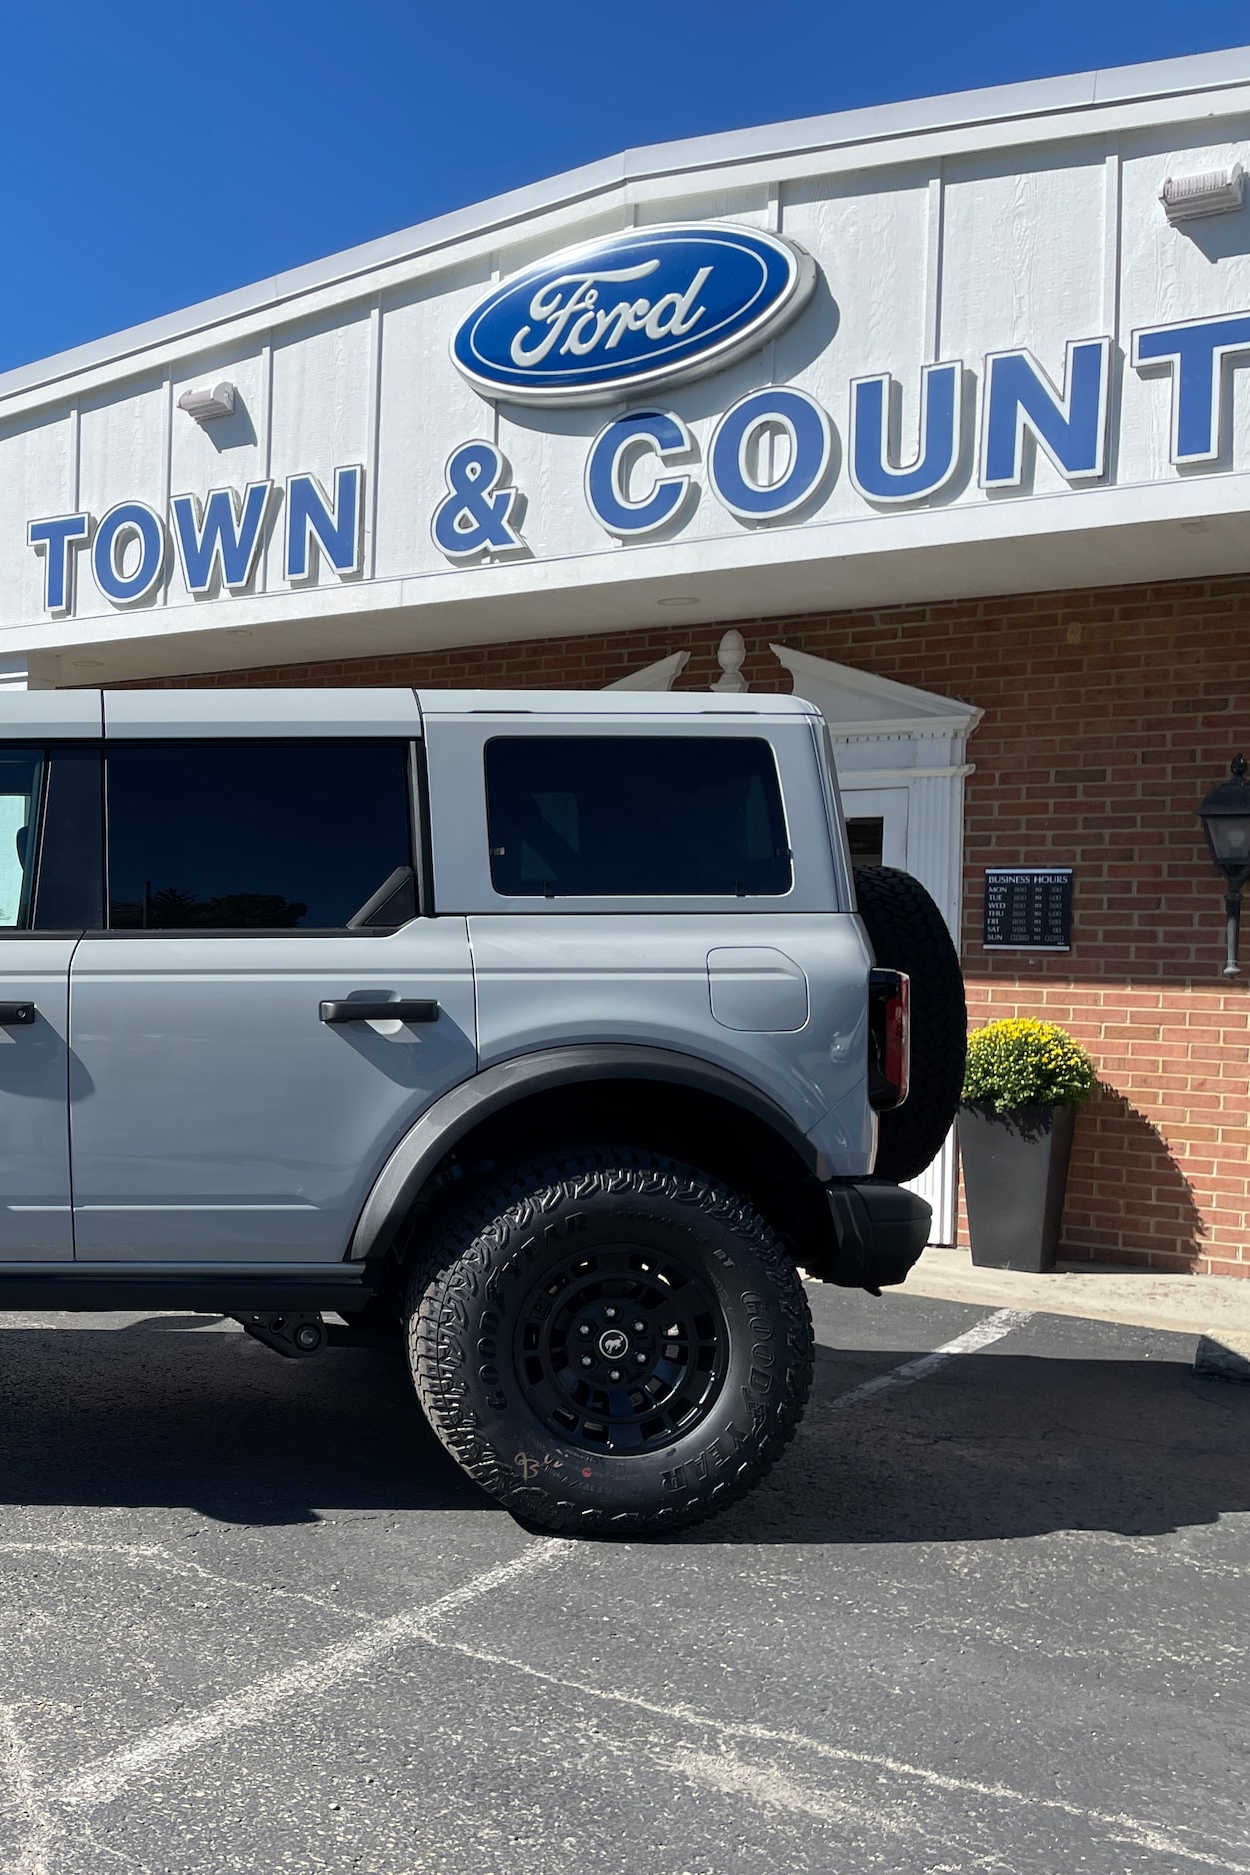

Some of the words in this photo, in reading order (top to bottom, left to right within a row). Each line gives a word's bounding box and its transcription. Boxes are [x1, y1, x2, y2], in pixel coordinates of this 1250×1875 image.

[510, 258, 712, 367] Ford
[26, 464, 365, 613] TOWN
[431, 439, 527, 559] &
[585, 310, 1250, 536] COUNT
[989, 875, 1031, 884] BUSINESS
[1034, 875, 1068, 884] HOURS
